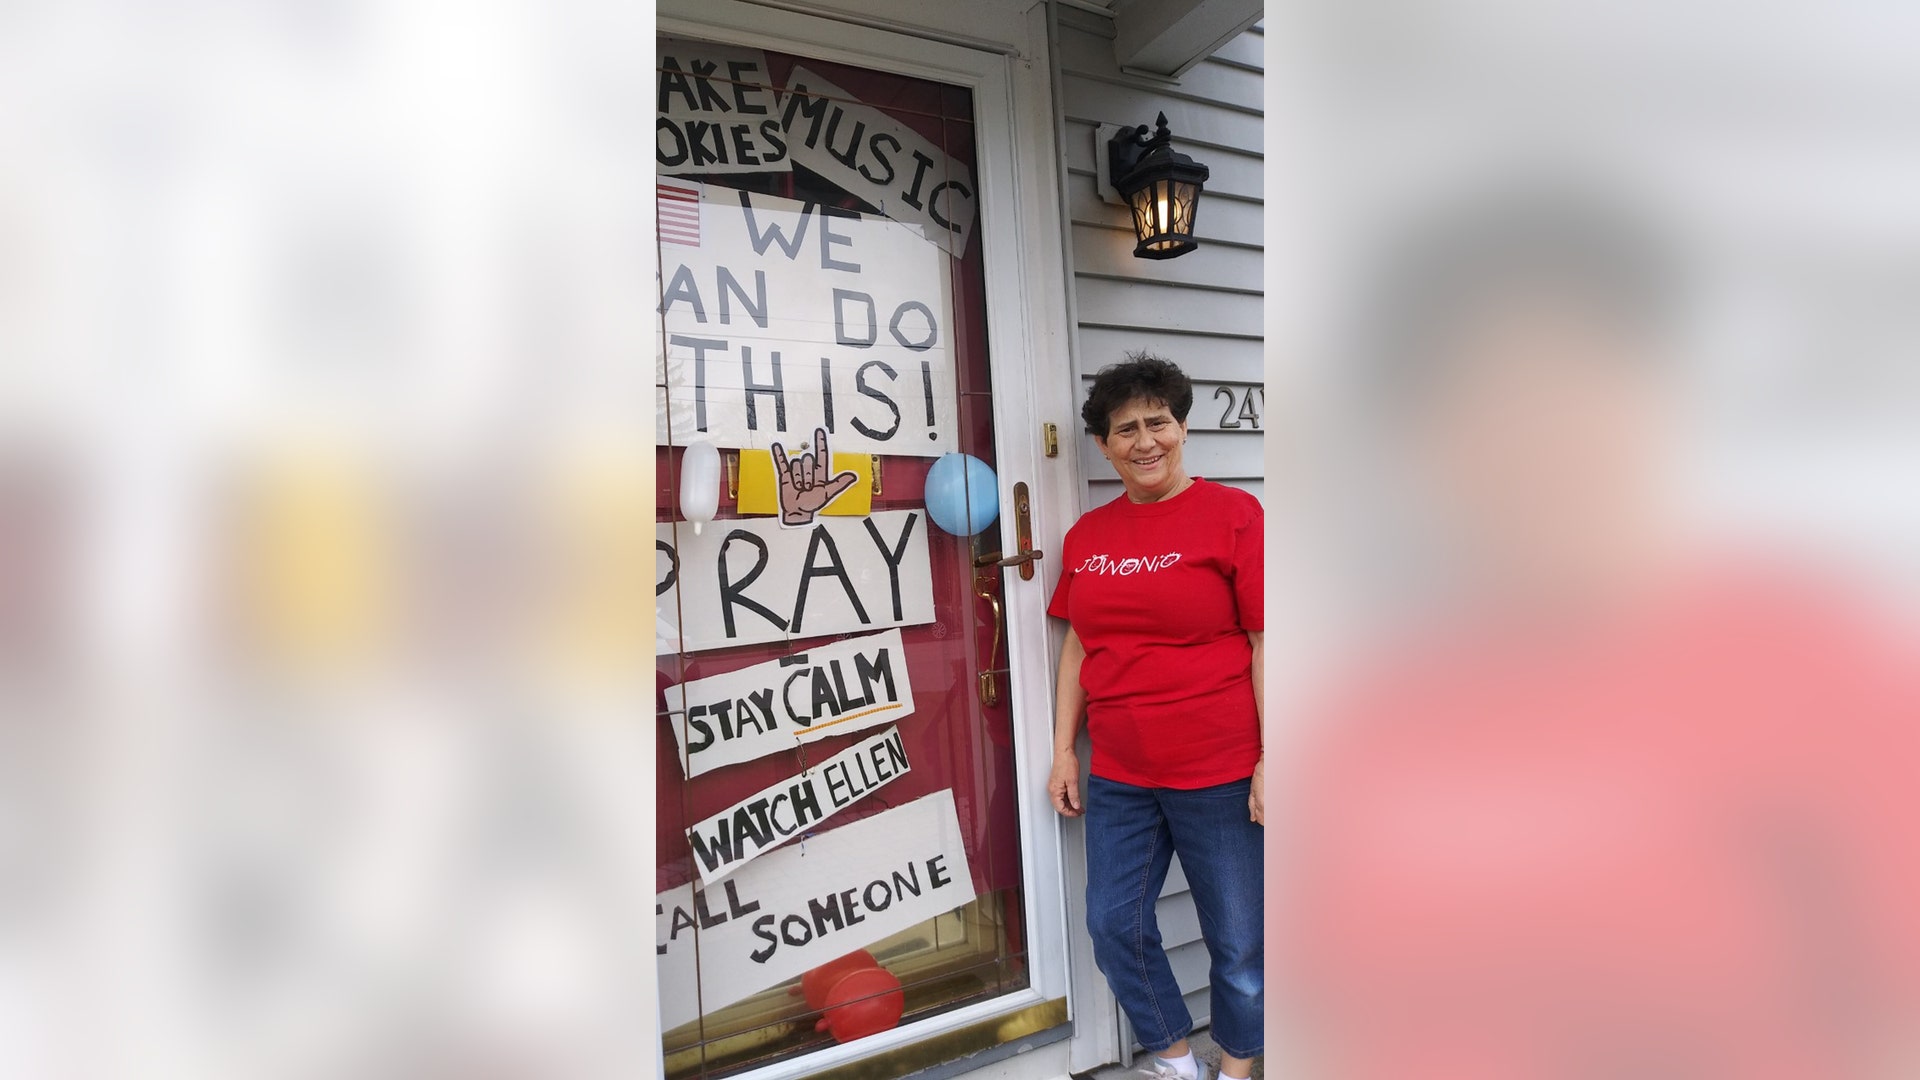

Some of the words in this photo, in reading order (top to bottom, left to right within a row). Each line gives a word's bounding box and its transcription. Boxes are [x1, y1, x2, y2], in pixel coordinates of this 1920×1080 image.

[781, 83, 972, 234] MUSIC
[738, 190, 861, 273] WE
[656, 263, 768, 328] AN
[832, 287, 938, 352] DO
[670, 334, 938, 441] THIS!
[1214, 386, 1264, 428] 24
[687, 688, 778, 754] STAY
[779, 648, 898, 727] CALM
[688, 779, 823, 873] WATCH
[822, 732, 909, 808] ELLEN
[656, 879, 760, 955] ALL
[750, 854, 952, 963] SOMEONE
